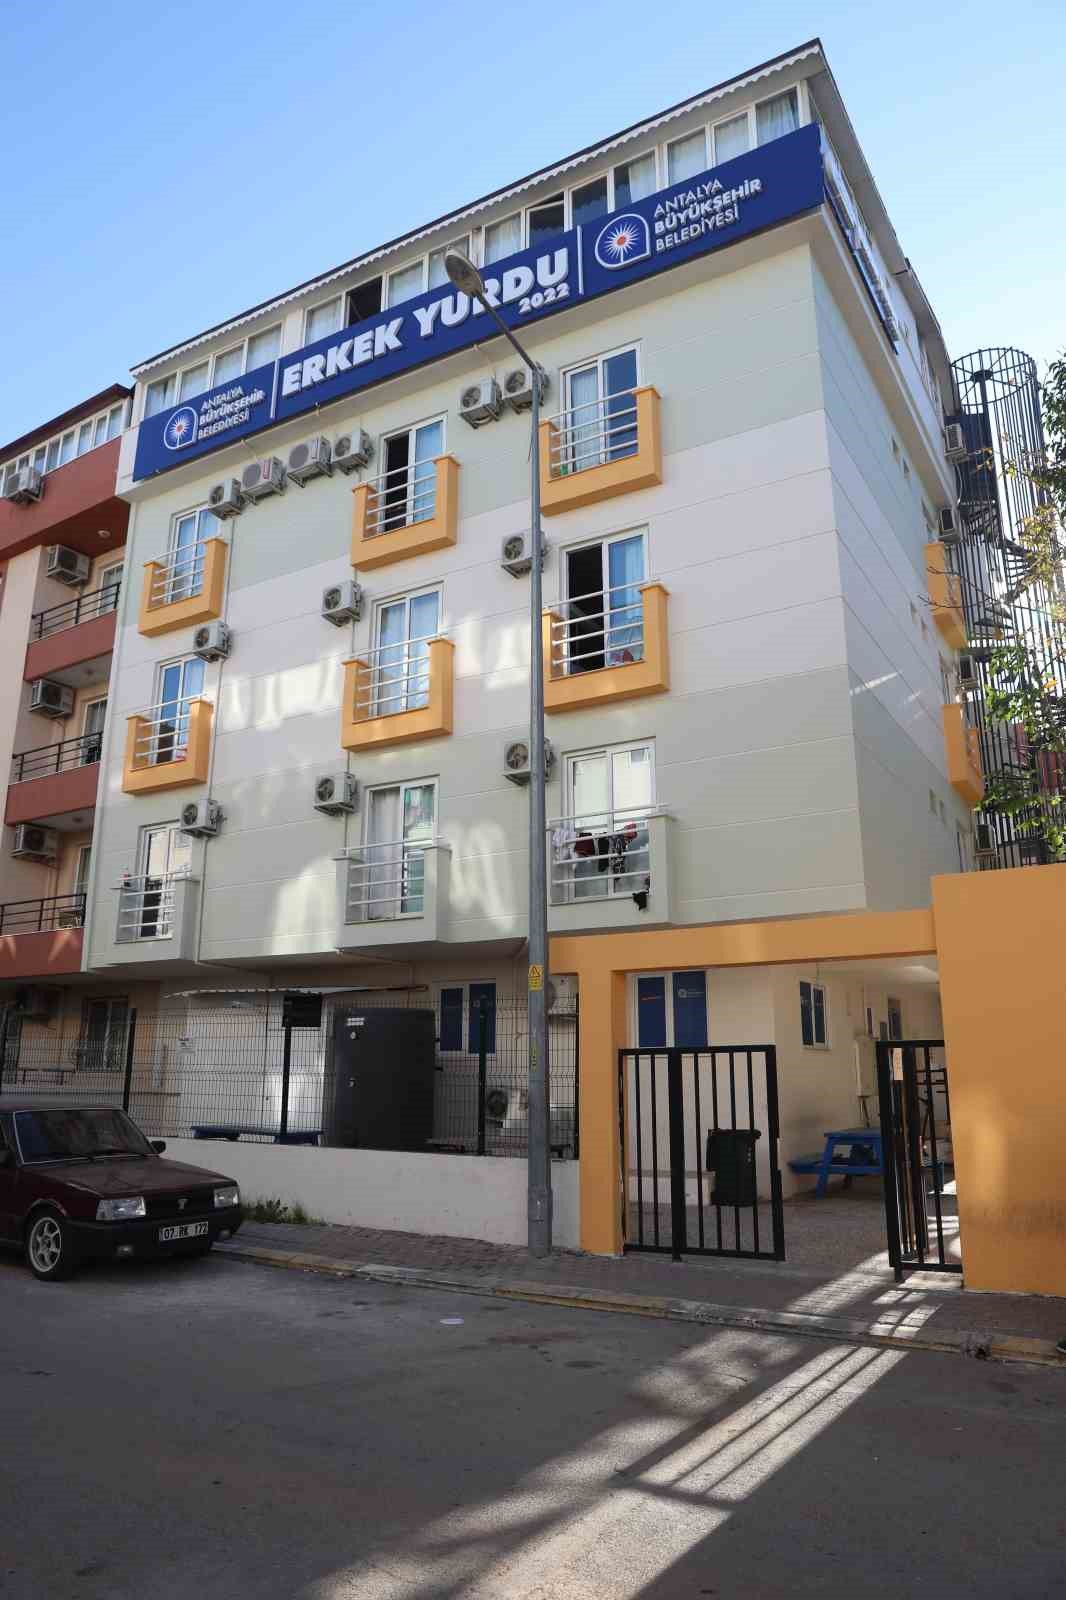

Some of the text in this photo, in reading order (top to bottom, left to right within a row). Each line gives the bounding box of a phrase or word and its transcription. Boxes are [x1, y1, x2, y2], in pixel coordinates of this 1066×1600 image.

[654, 178, 723, 218] ANTALYA
[654, 178, 763, 235] BÜYÜKŞEHİR
[655, 203, 740, 252] BELEDİYESİ
[518, 282, 570, 315] 2022
[281, 247, 569, 397] ERKEK YURDU
[199, 388, 266, 426] BÜYÜKŞEHİR
[200, 385, 245, 412] ANTALYA
[198, 407, 250, 440] BELEDİYESİ
[164, 1227, 175, 1240] 07
